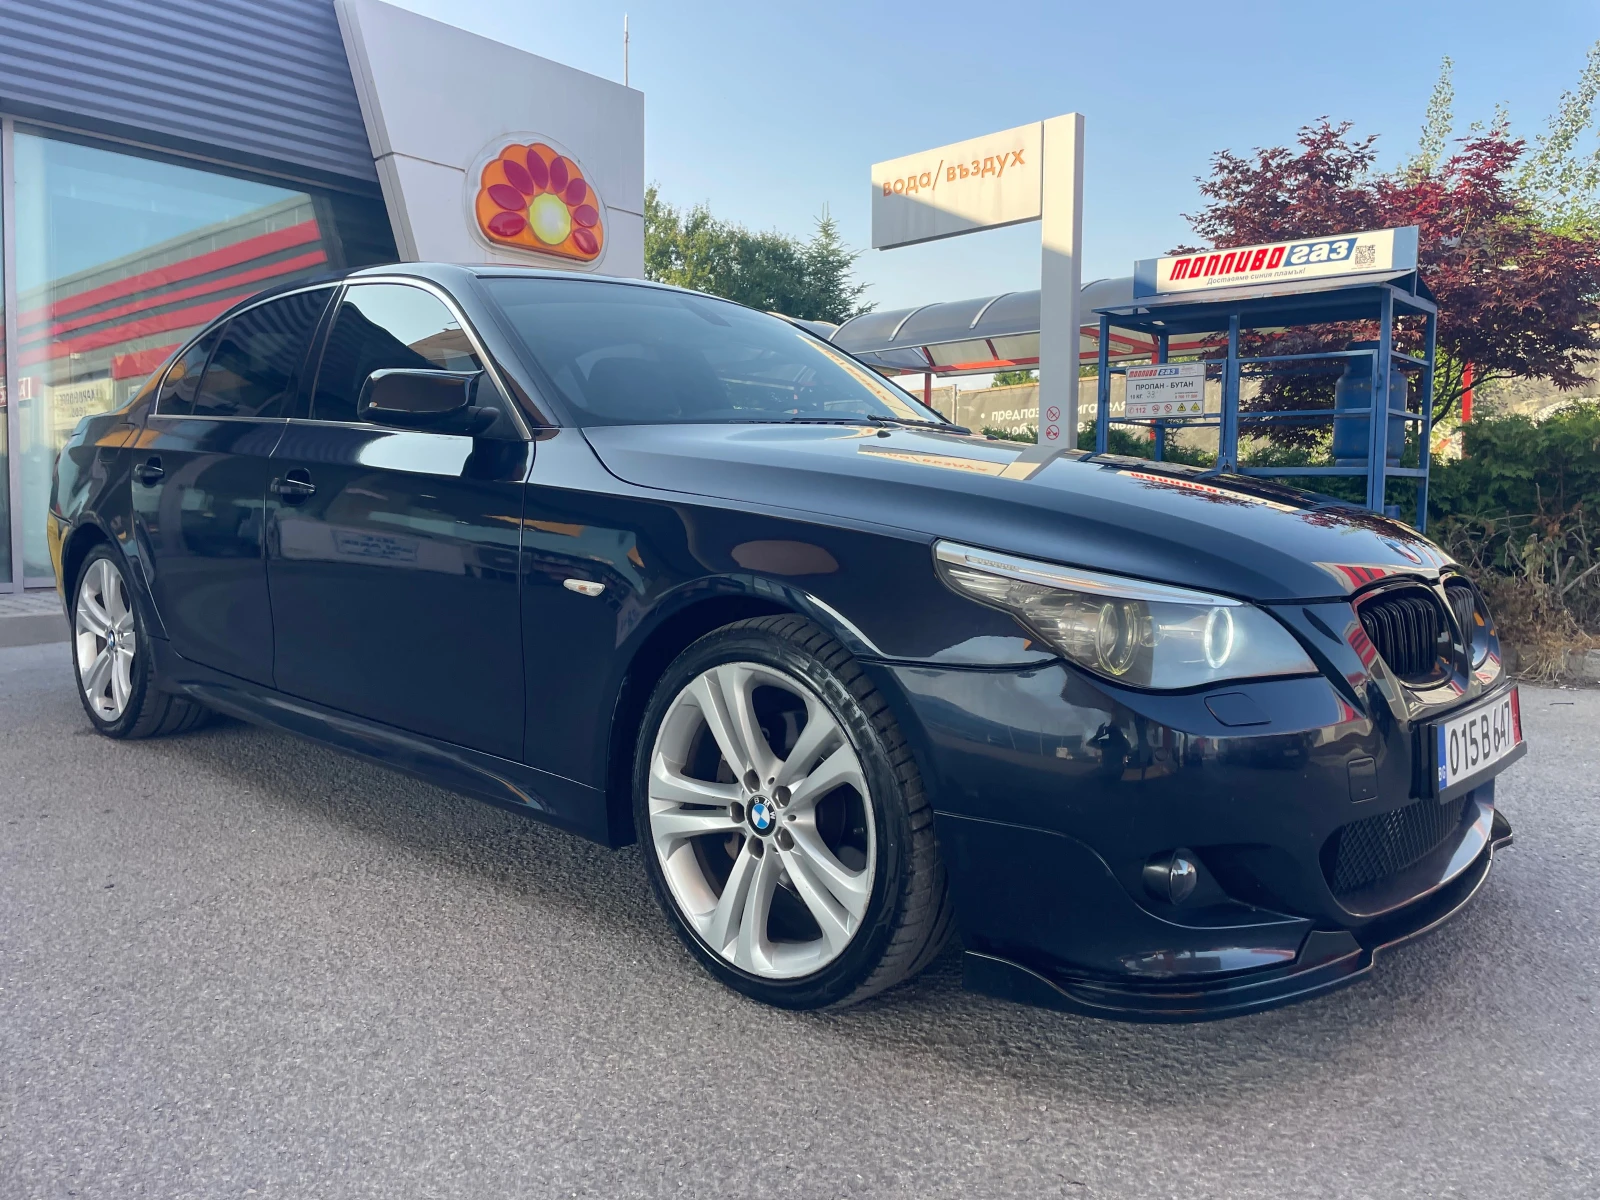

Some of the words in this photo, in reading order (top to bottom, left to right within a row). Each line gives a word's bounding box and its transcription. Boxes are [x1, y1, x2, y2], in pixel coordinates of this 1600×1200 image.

[882, 148, 1026, 198] вода/въздух
[1135, 383, 1165, 391] ПРОПАН
[1170, 381, 1194, 389] БУТАН
